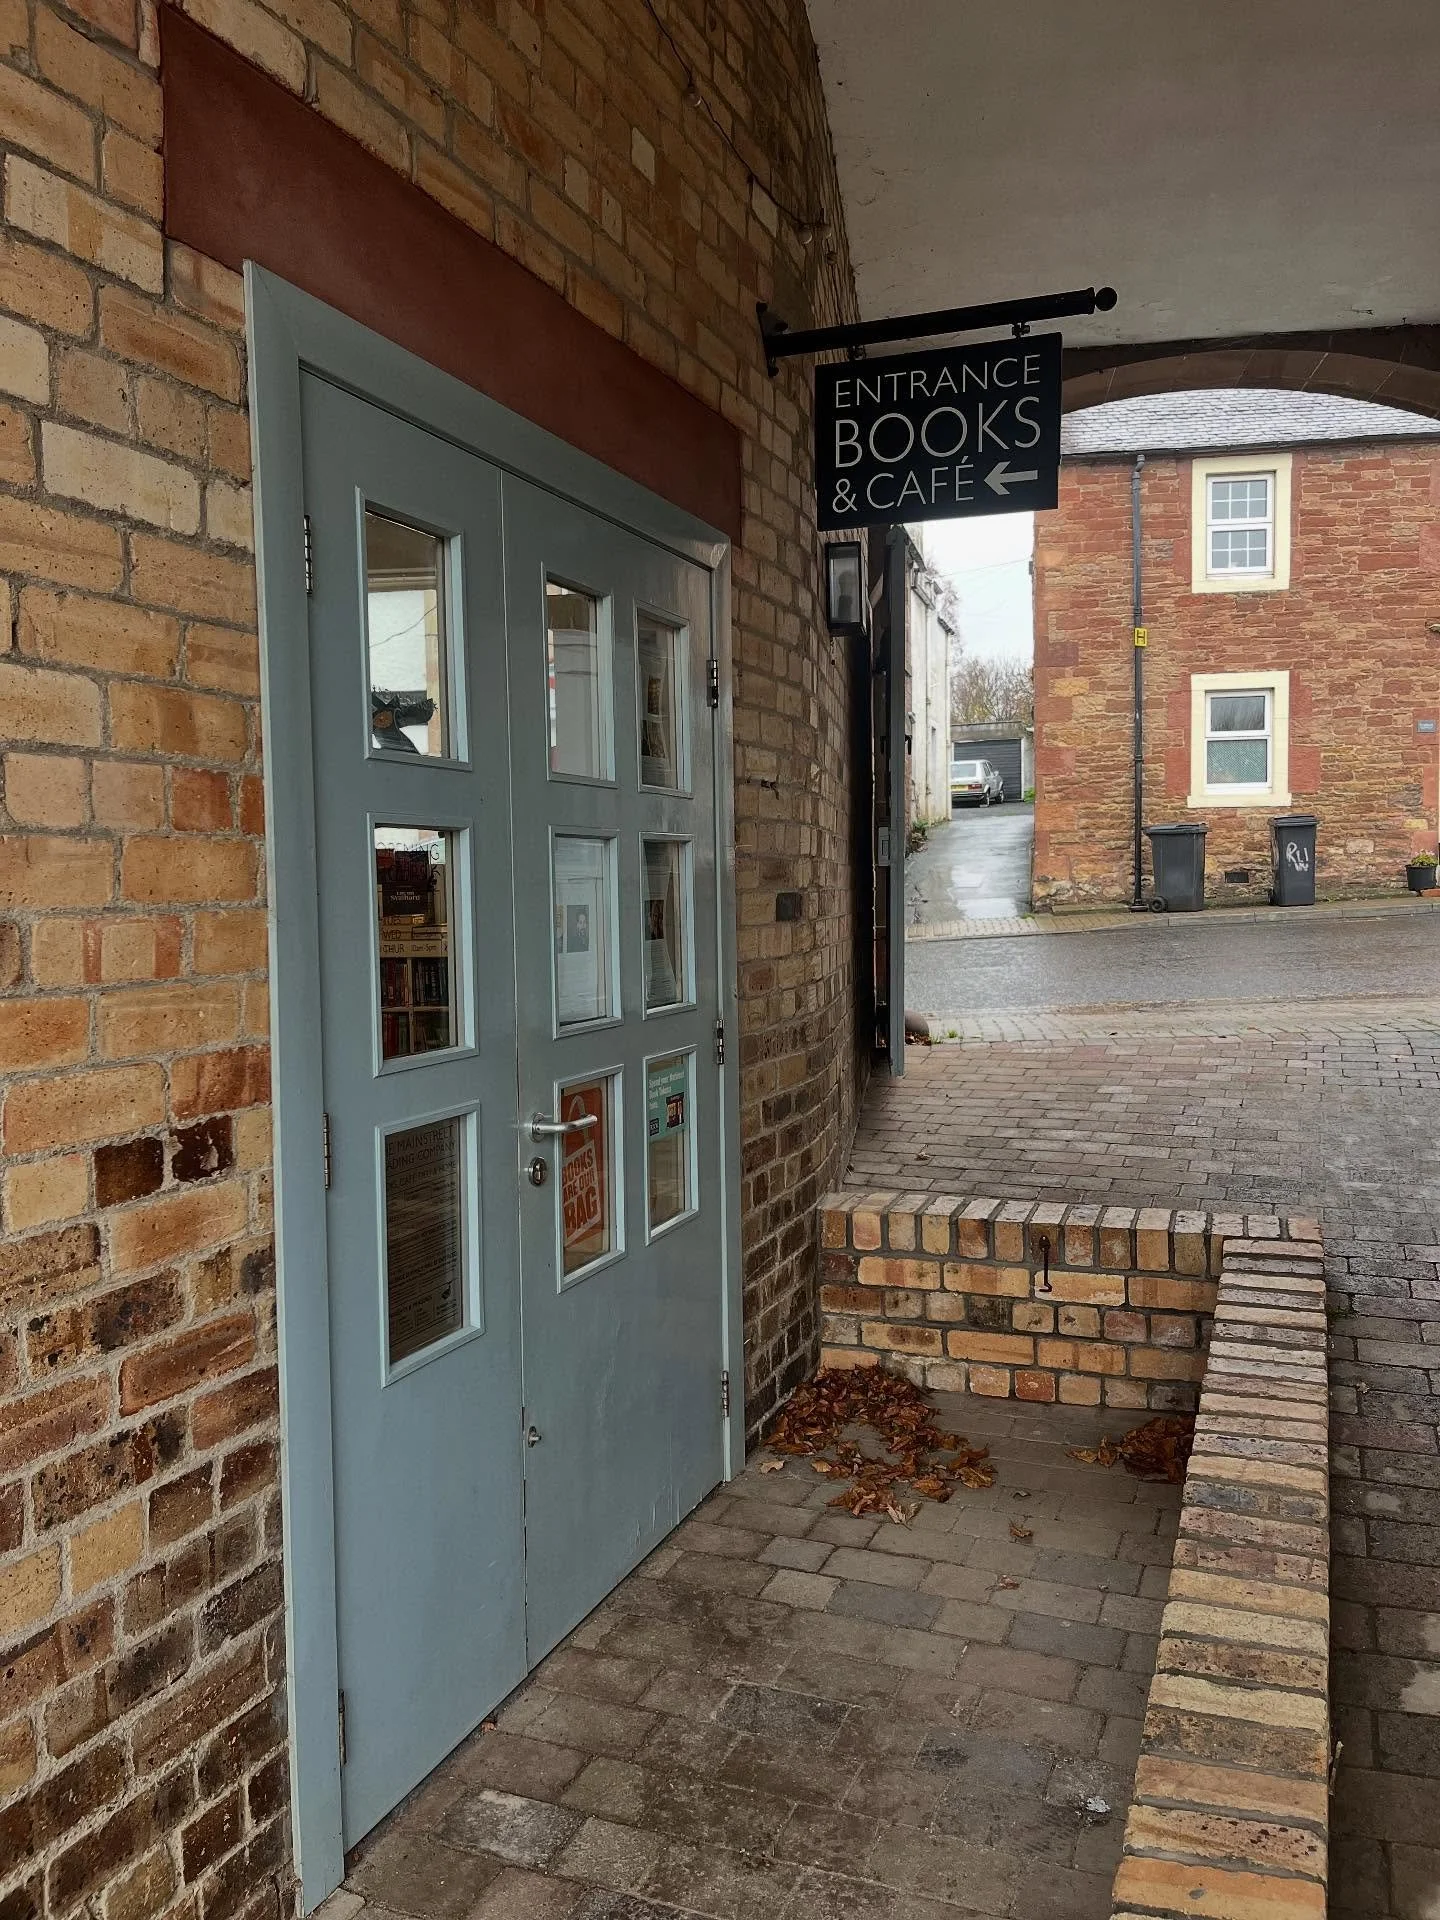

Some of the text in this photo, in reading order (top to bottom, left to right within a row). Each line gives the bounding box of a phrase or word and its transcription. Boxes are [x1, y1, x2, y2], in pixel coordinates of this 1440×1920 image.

[835, 354, 1041, 408] ENTRANCE
[834, 396, 1041, 468] BOOKS
[832, 455, 974, 513] & CAFÉ
[418, 1142, 455, 1161] COMPANY
[562, 1148, 594, 1186] BOOKS
[579, 1167, 595, 1191] OUR
[564, 1186, 598, 1231] BAG
